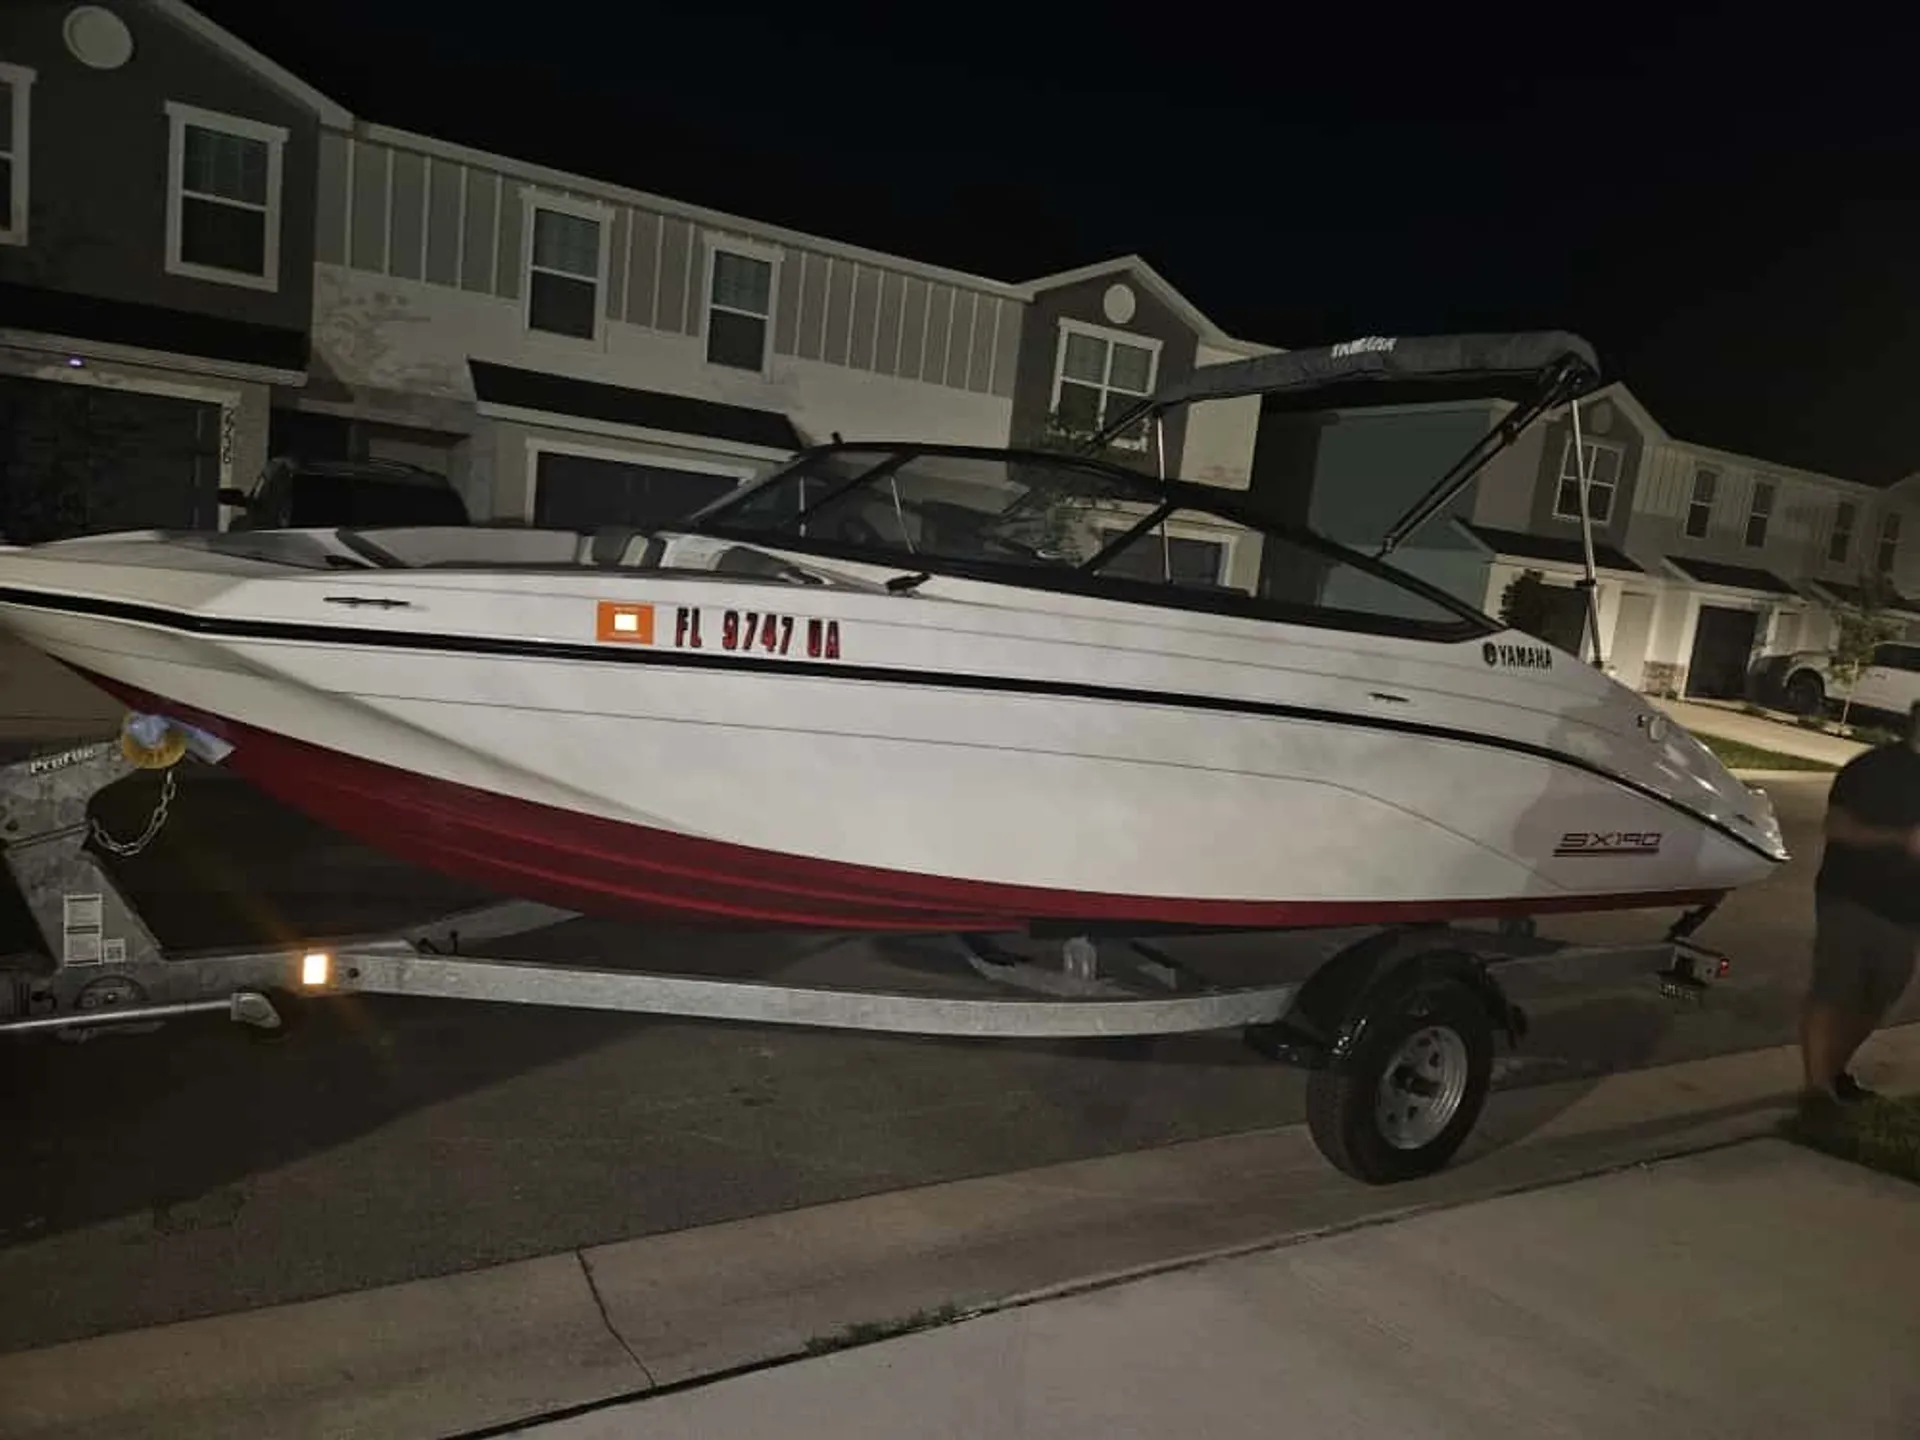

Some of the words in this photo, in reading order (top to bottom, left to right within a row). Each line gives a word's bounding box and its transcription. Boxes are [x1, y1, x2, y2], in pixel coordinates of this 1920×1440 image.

[675, 607, 703, 648] FL
[722, 610, 794, 655] 9747
[1497, 644, 1553, 670] YAMAHA
[1560, 832, 1662, 848] SX190
